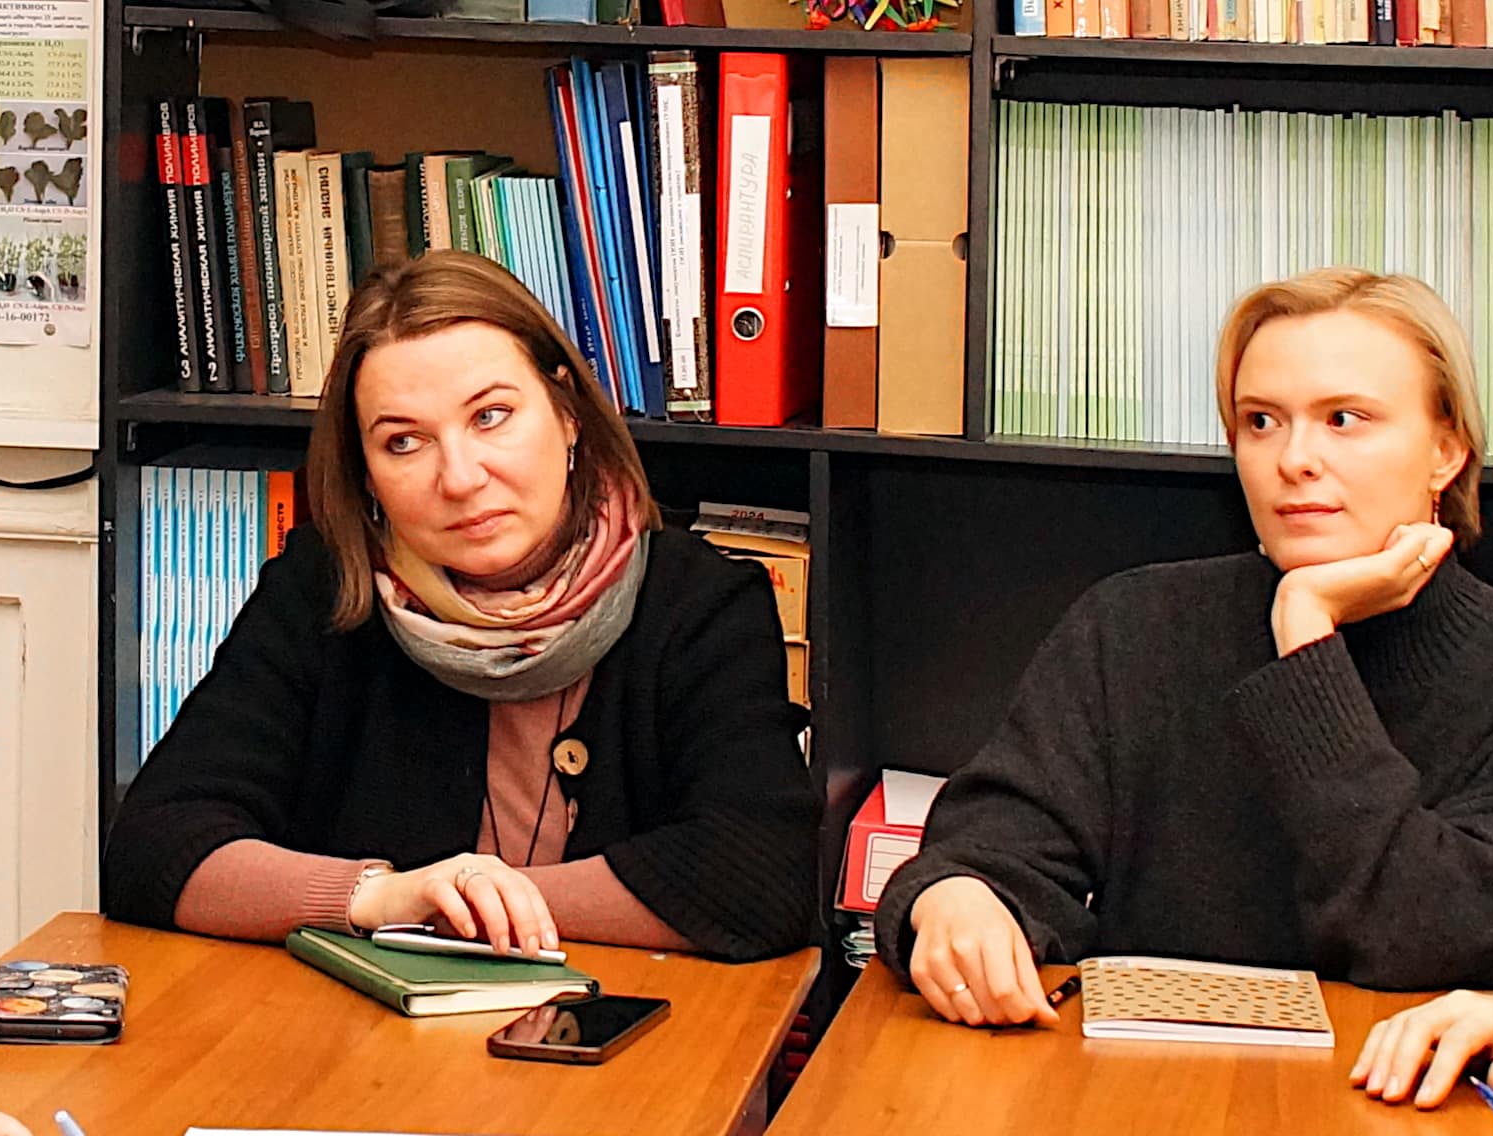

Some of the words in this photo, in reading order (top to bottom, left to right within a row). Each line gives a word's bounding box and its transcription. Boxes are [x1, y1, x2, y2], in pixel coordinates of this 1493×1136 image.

[159, 102, 175, 185] ПОЛИМЕРОВ
[186, 103, 202, 186] ПОЛИМЕРОВ
[166, 189, 180, 239] ХИМИЯ
[193, 190, 207, 241] ХИМИЯ
[318, 166, 331, 219] анализ
[259, 205, 277, 299] полимерной
[319, 226, 339, 334] качественный
[169, 242, 190, 356] АНАЛИТИЧЕСКАЯ
[198, 244, 216, 358] АНАЛИТИЧЕСКАЯ
[266, 302, 282, 375] Прогресс
[207, 361, 219, 382] 2
